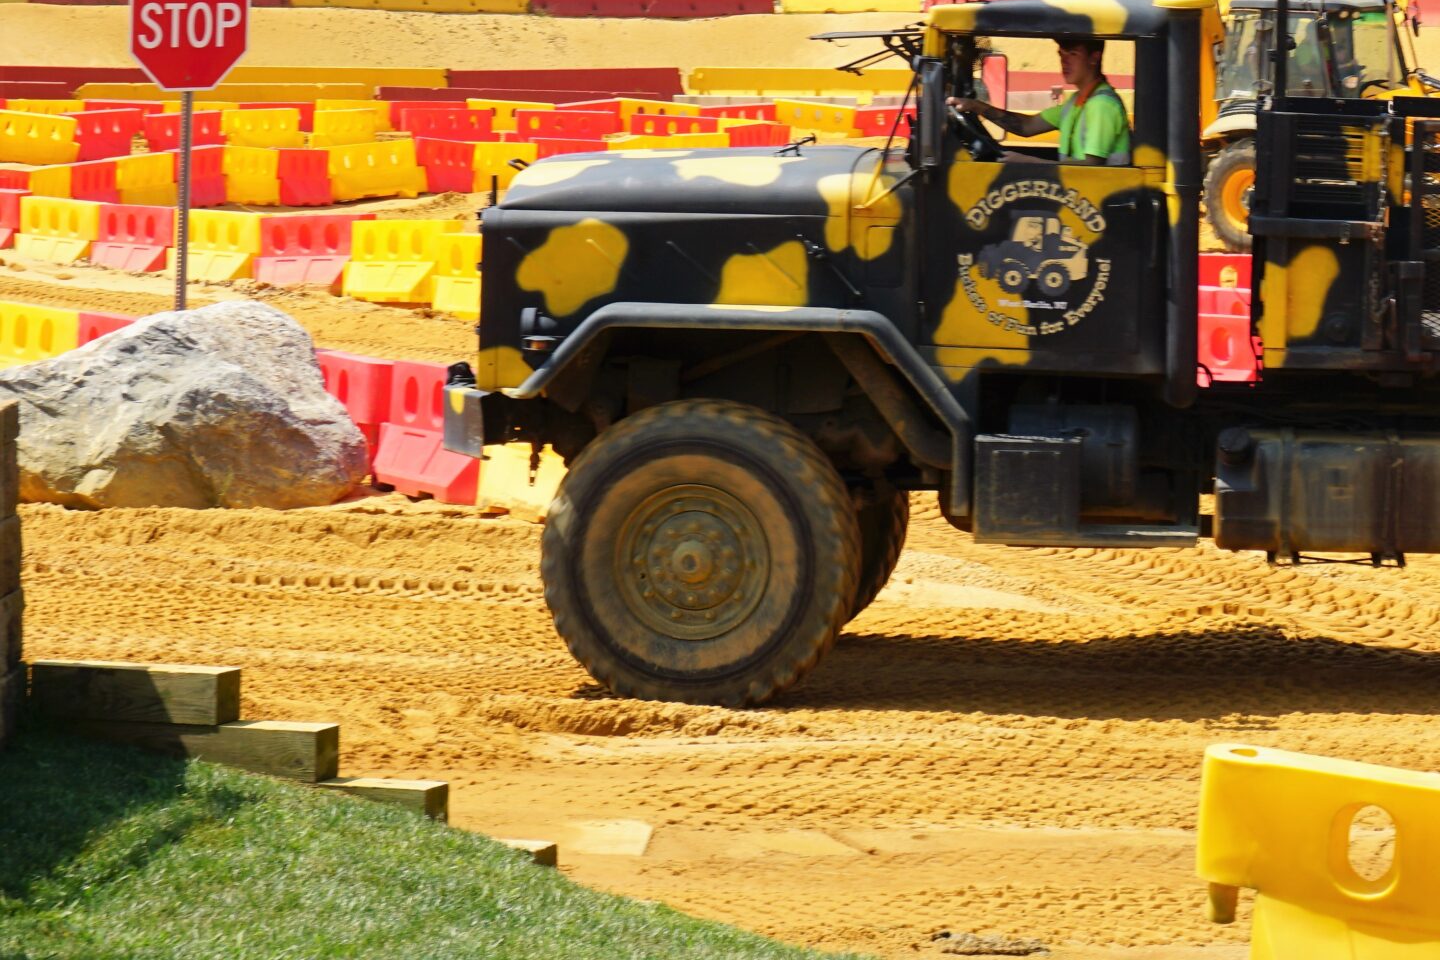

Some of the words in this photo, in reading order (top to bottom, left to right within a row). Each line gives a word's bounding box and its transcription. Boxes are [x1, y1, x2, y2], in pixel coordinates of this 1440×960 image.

[138, 2, 242, 49] STOP
[965, 180, 1107, 232] DIGGERLAND
[956, 253, 988, 313] Buckets
[987, 311, 1006, 326] of
[1004, 317, 1038, 336] Fun
[1039, 321, 1065, 336] for
